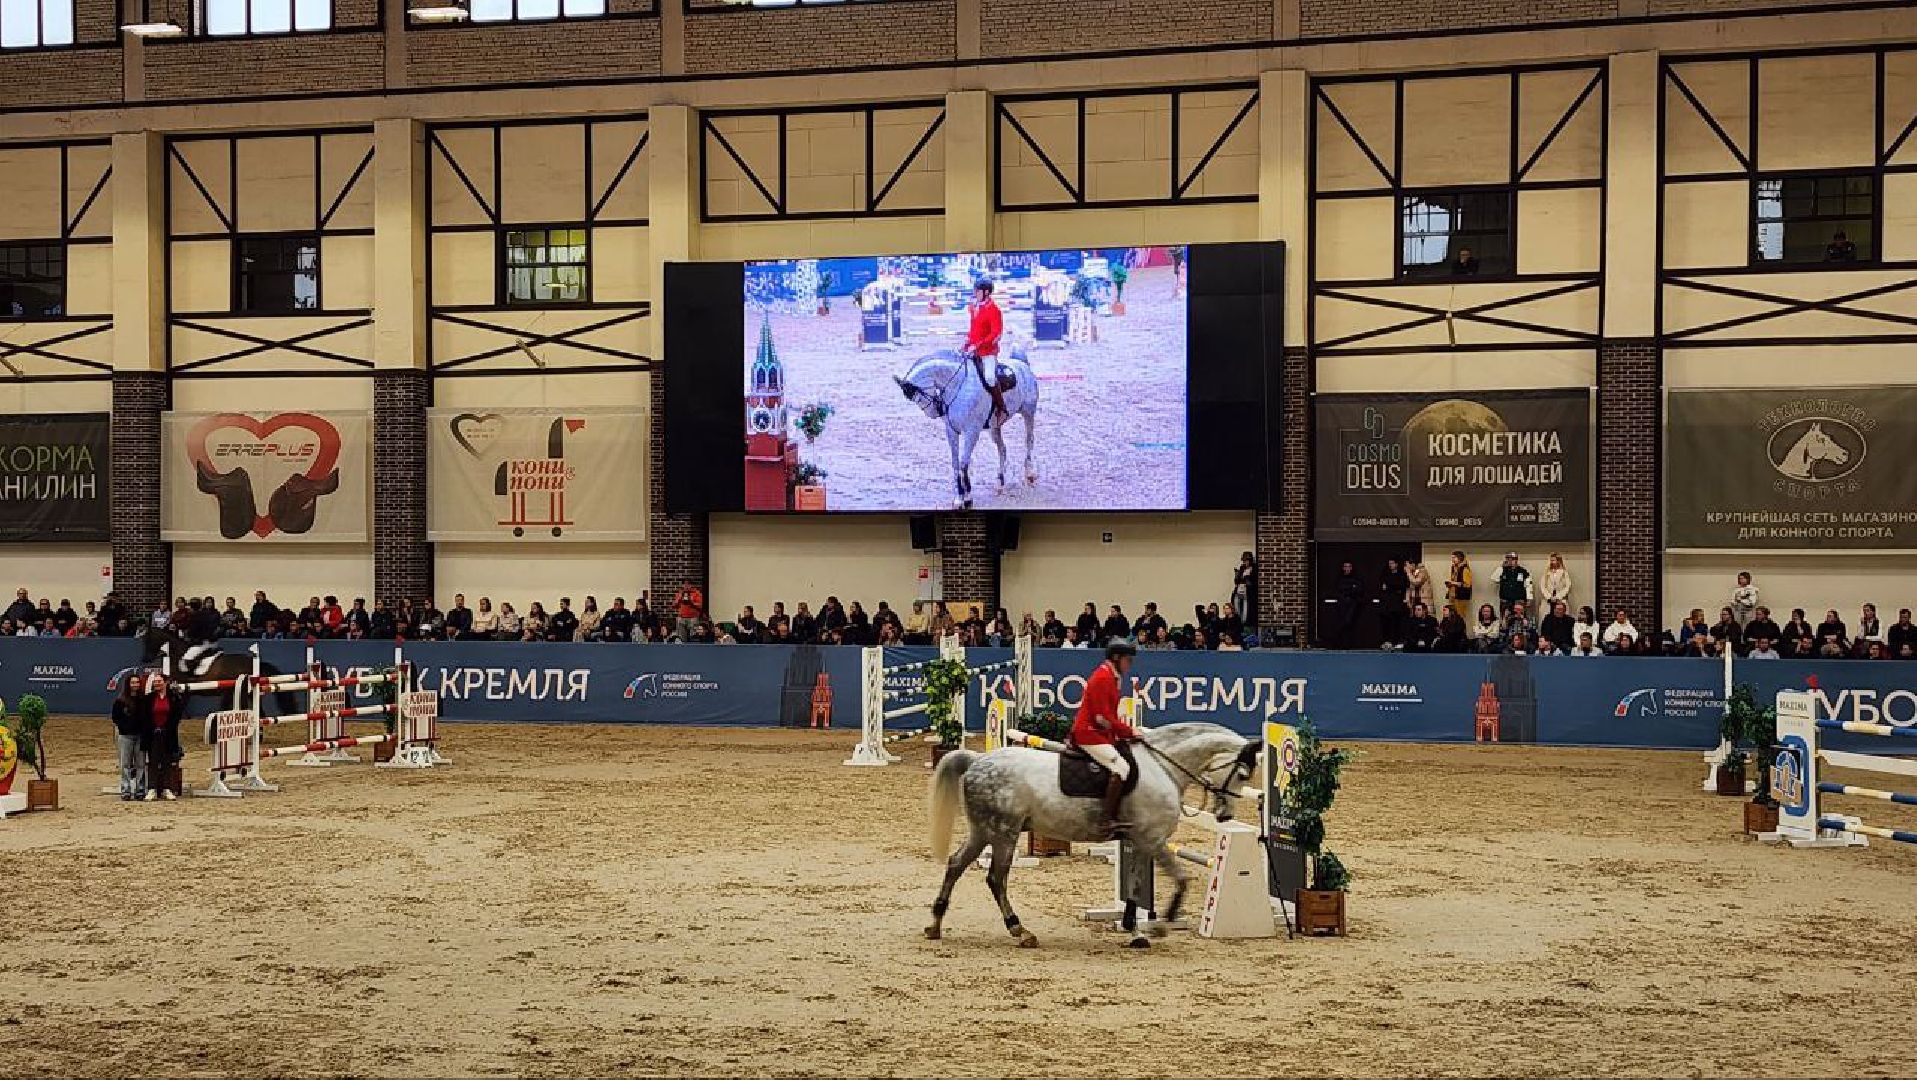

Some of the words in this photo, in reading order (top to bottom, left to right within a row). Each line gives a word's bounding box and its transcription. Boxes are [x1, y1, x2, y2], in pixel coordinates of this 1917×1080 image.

[215, 443, 316, 457] ERREPLUS
[1428, 431, 1563, 457] КОСМЕТИКА
[1347, 443, 1401, 462] COSMO
[1347, 463, 1401, 489] DEUS
[1427, 465, 1466, 487] ДЛЯ
[1471, 461, 1563, 486] ЛОШАДЕЙ
[1706, 509, 1800, 523] КРУПНЕЙШАЯ
[1804, 512, 1838, 523] СЕТЬ
[1738, 528, 1767, 540] ДЛЯ
[1770, 527, 1835, 538] КОННОГО
[1838, 528, 1895, 539] СПОРТА
[33, 666, 74, 675] MAXIMA
[440, 667, 591, 702] КРЕМЛЯ
[1361, 683, 1417, 695] MAXIMA
[1131, 676, 1308, 713] КРЕМЛЯ
[1664, 689, 1714, 699] ФЕДЕРАЦИЯ
